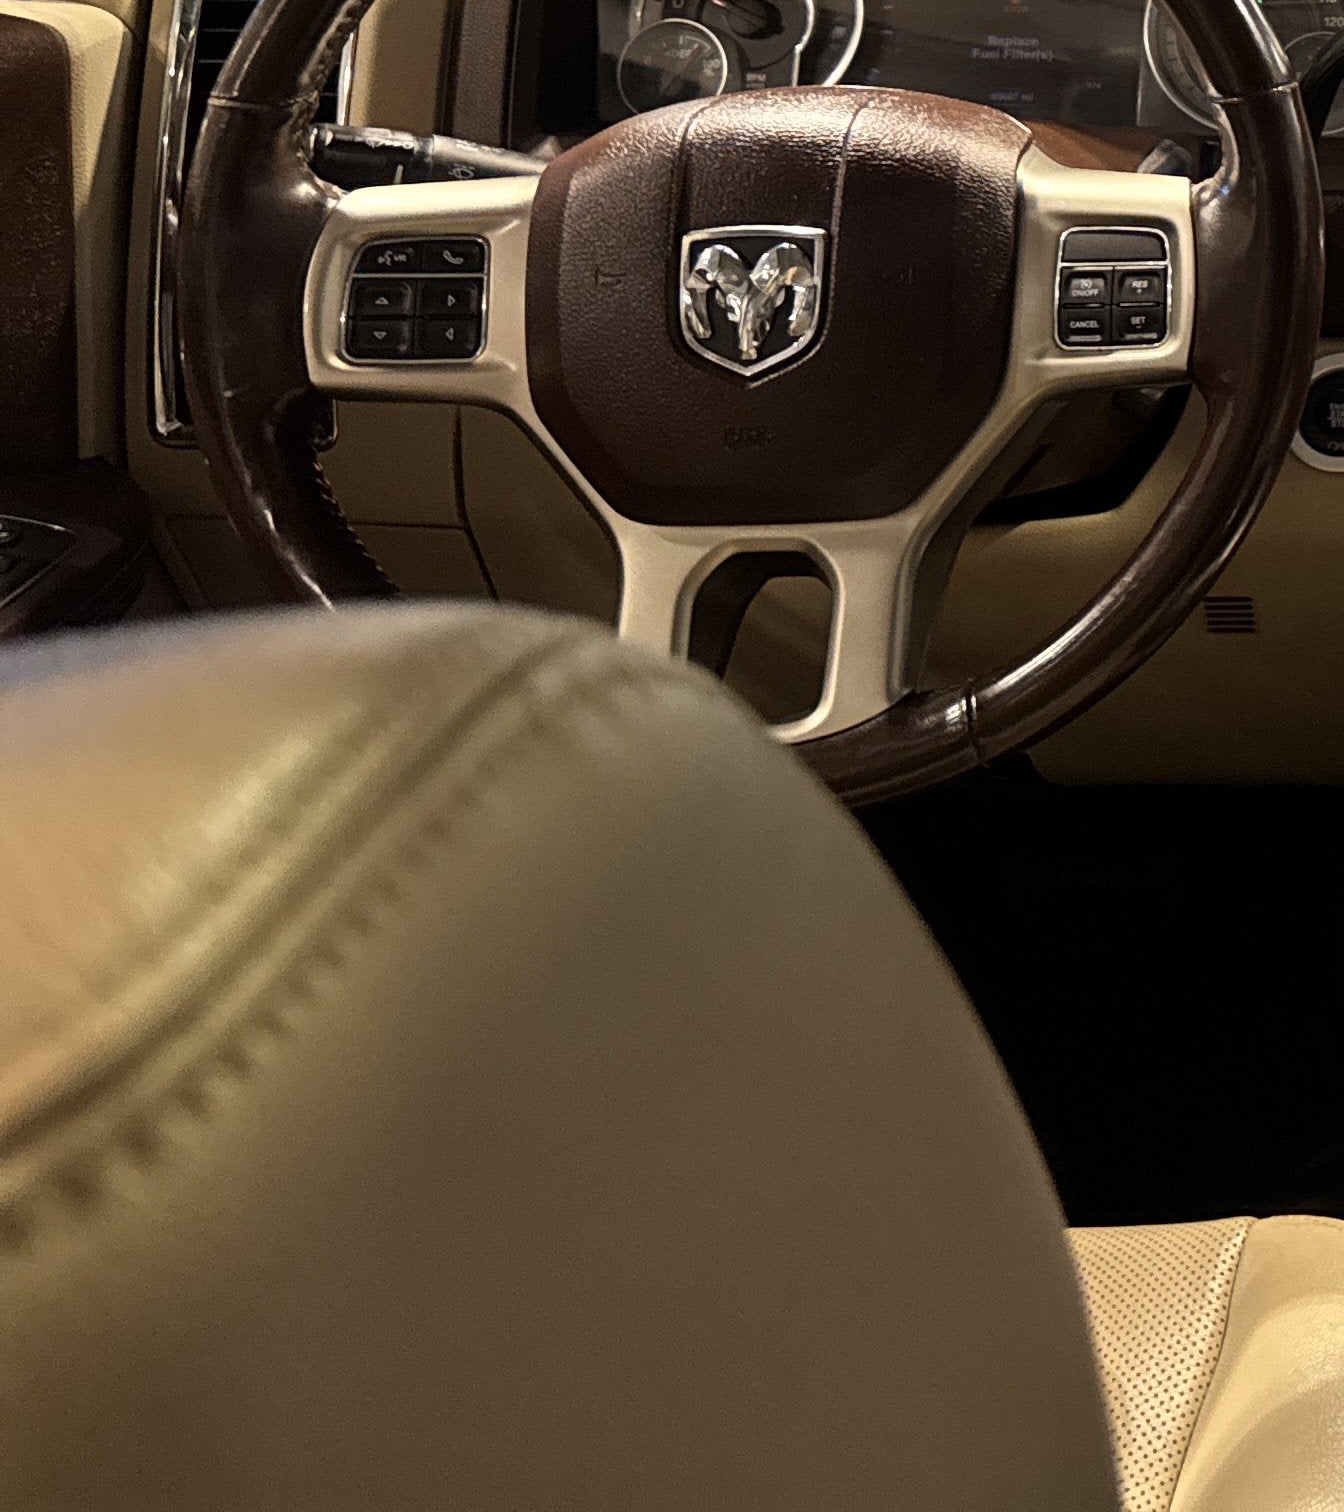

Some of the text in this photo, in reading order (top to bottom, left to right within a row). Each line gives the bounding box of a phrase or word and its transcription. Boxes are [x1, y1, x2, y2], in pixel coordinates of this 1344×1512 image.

[986, 35, 1040, 48] Replace
[970, 47, 1054, 62] Fuel Filter(s)
[1131, 279, 1149, 289] RES
[1071, 288, 1100, 298] ON/OFF
[1069, 320, 1100, 329] CANCEL
[1130, 315, 1146, 325] SET
